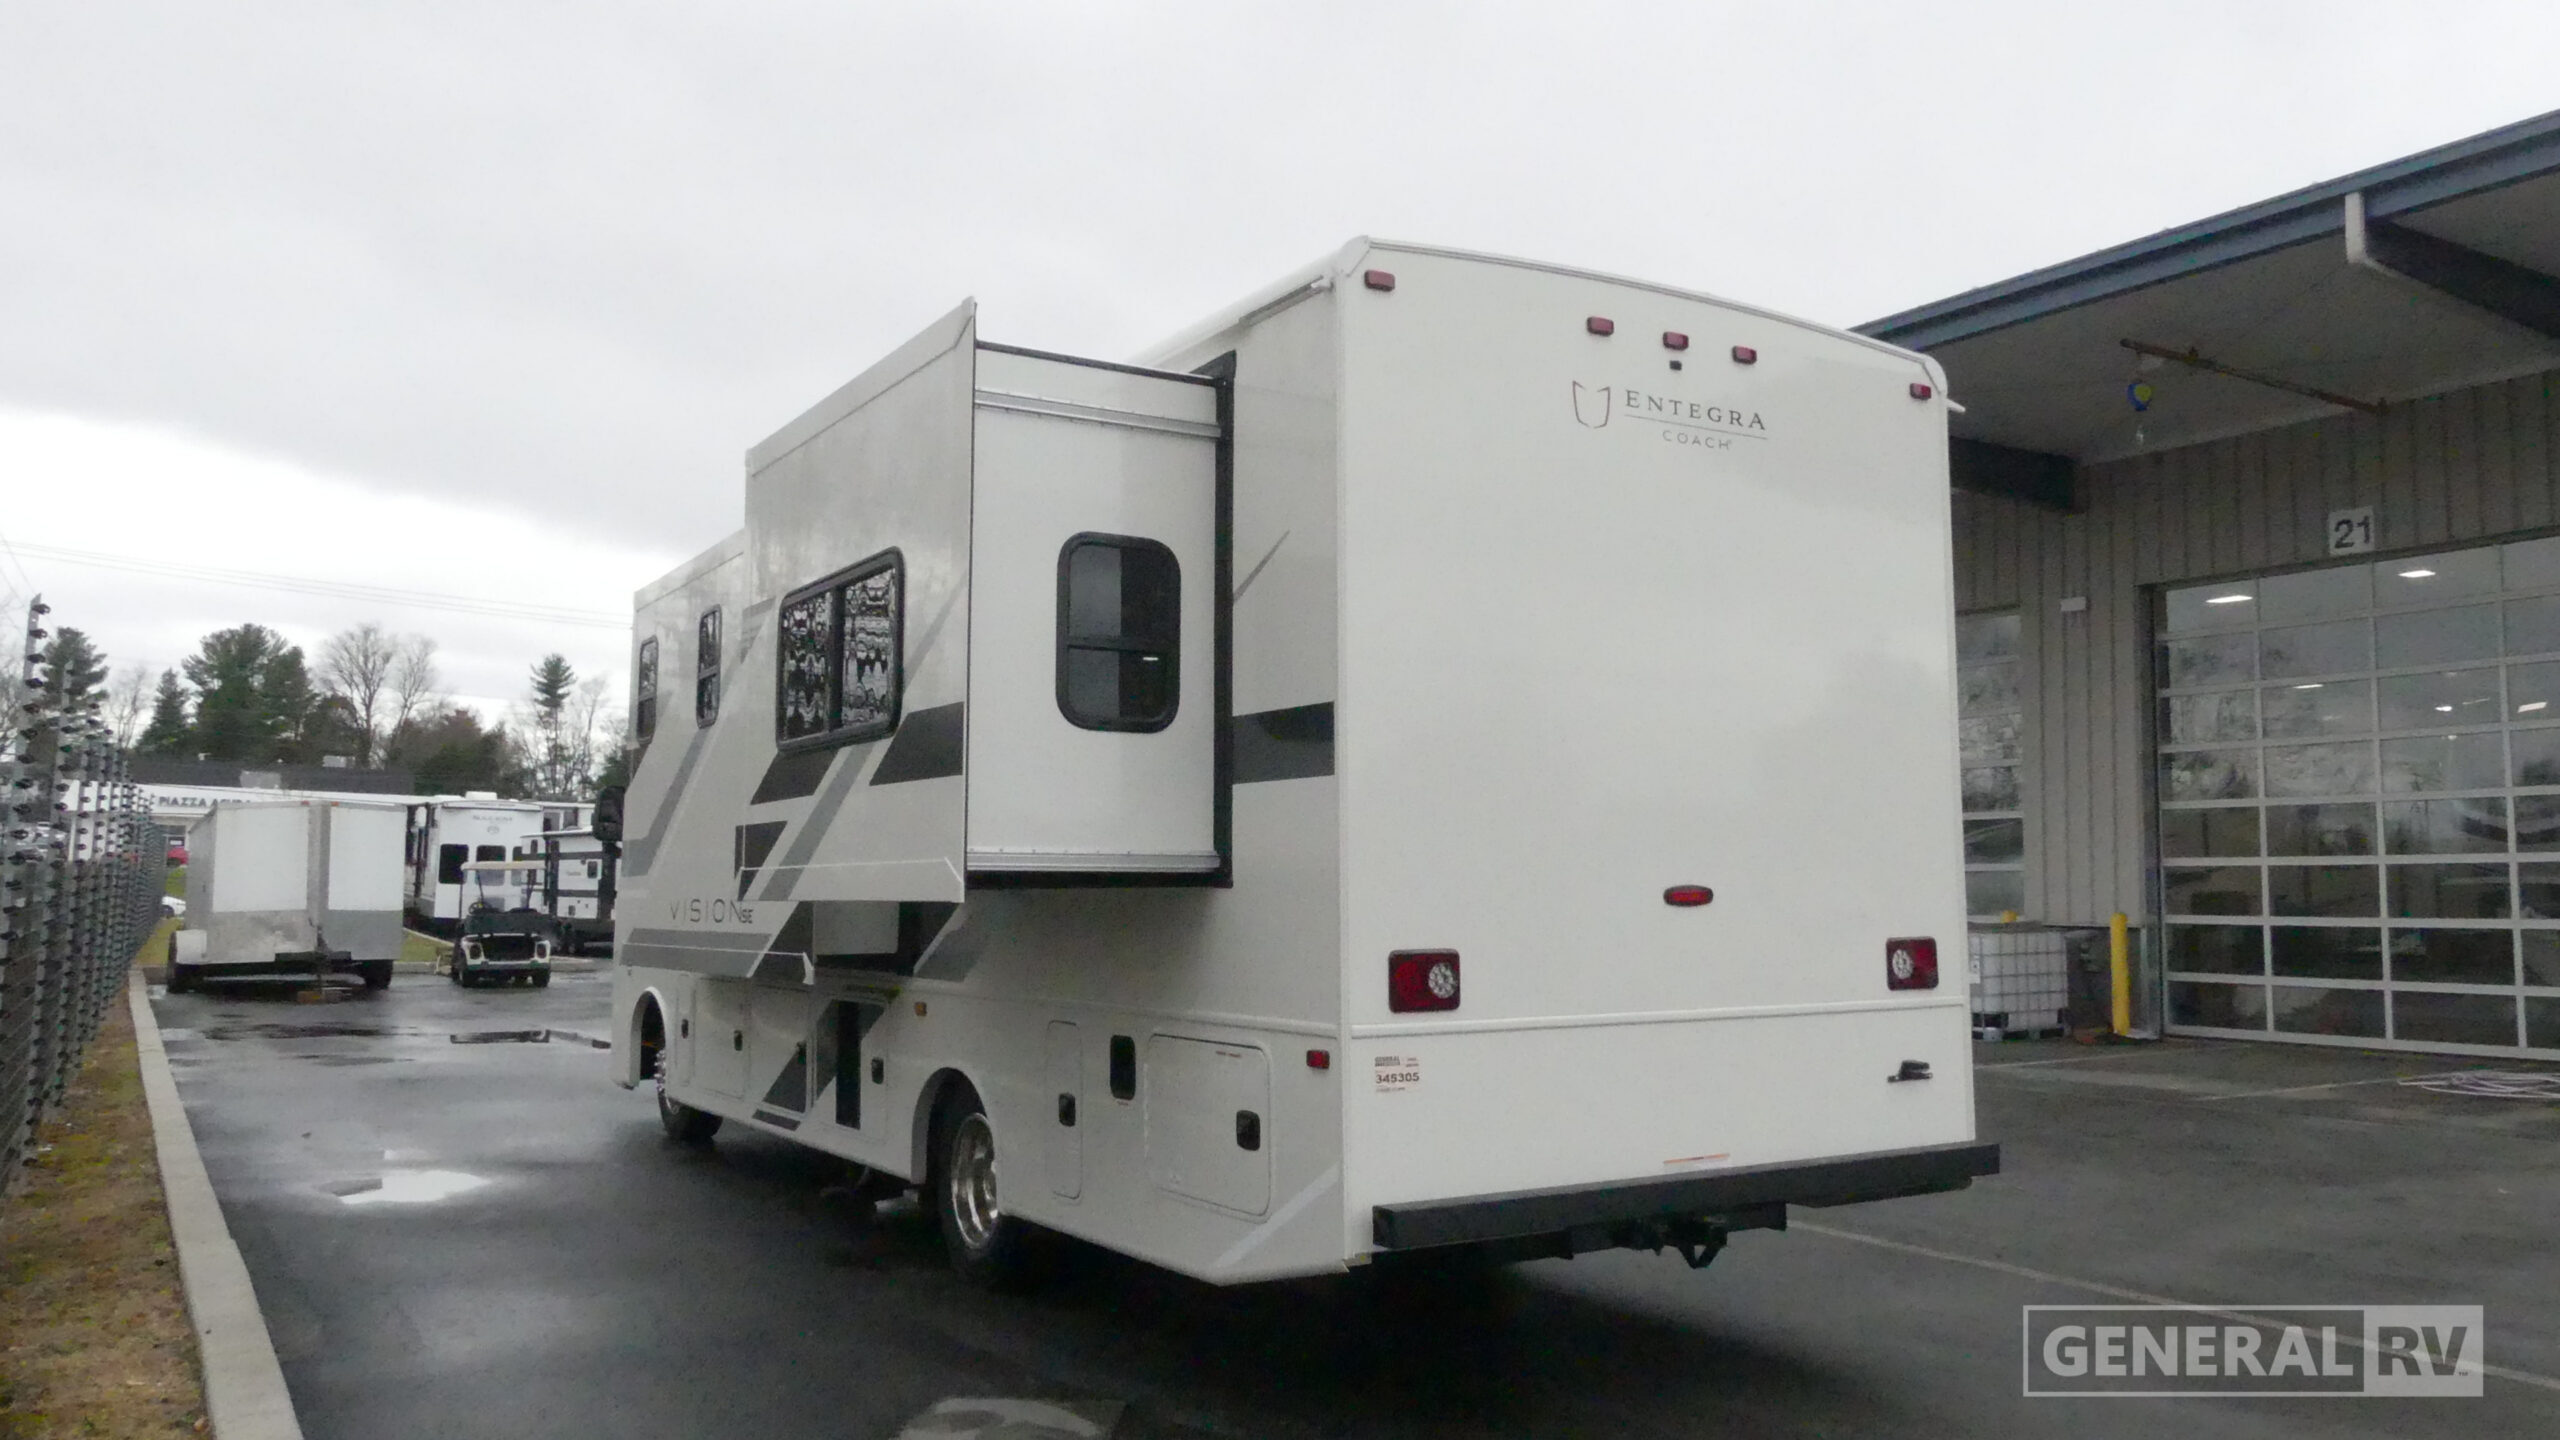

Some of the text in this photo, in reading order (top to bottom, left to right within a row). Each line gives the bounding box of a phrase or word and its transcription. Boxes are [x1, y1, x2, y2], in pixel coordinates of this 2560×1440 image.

[1625, 389, 1766, 431] ENTEGRA
[1662, 429, 1730, 450] COACH
[2334, 515, 2370, 549] 21
[159, 796, 207, 807] PIAZZA
[670, 898, 742, 923] VISION
[1375, 1072, 1420, 1084] 345305
